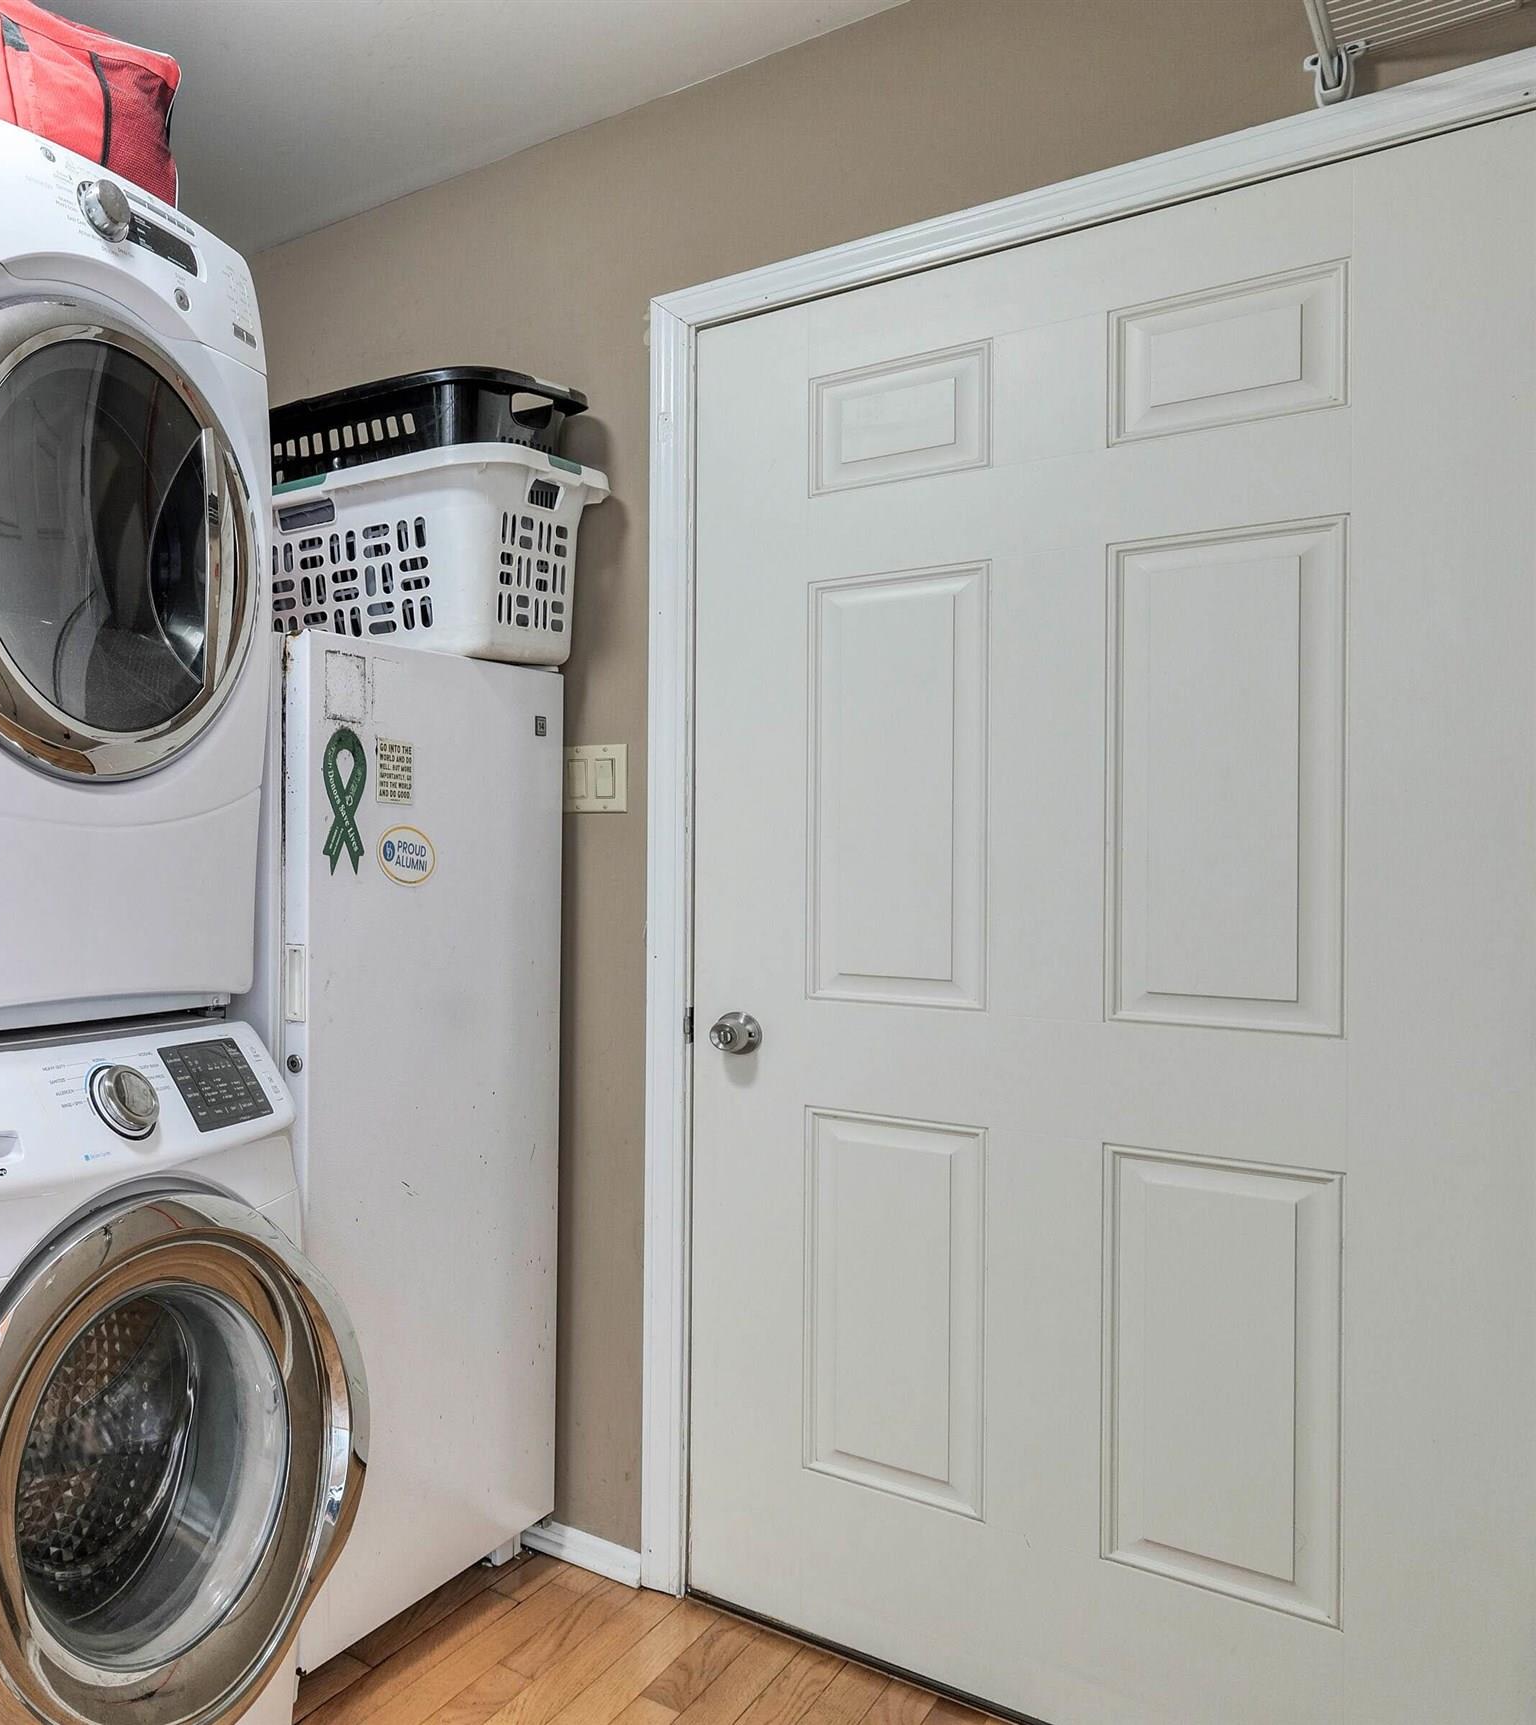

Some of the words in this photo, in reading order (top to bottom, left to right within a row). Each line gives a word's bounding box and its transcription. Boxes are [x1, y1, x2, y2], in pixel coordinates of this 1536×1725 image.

[379, 743, 388, 752] GO
[388, 744, 401, 754] INTO
[402, 746, 412, 755] THE
[379, 753, 395, 762] WORLD
[406, 756, 412, 764] DO
[379, 789, 389, 797] AND
[389, 789, 396, 797] DO
[328, 770, 341, 805] Donors
[339, 804, 351, 827] Save
[348, 827, 360, 852] Lives
[397, 840, 427, 857] PROUD
[395, 854, 427, 872] ALUMNI
